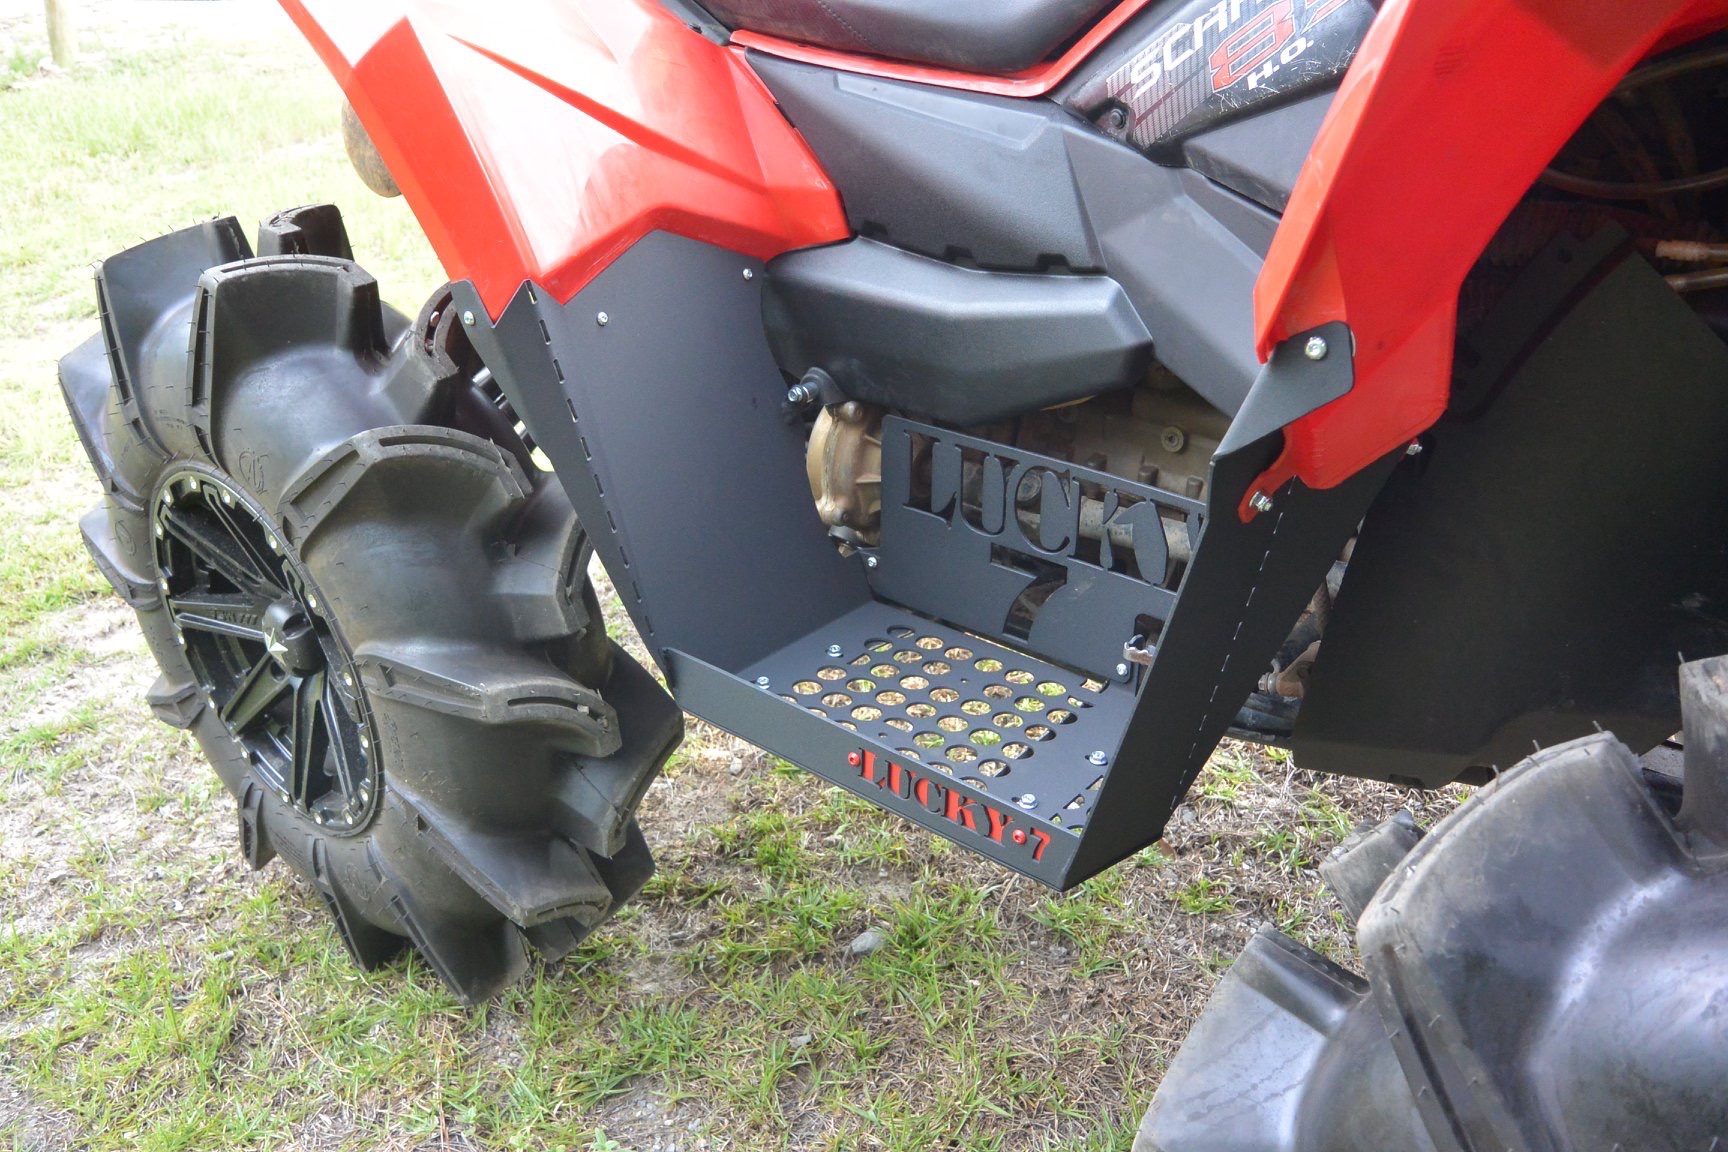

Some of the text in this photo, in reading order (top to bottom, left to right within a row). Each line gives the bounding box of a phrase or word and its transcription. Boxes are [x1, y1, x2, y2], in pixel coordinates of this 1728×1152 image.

[1246, 38, 1315, 91] H.O.
[903, 429, 1204, 596] LUCKY
[990, 542, 1068, 645] 7
[858, 747, 1051, 864] LUCKY 7
